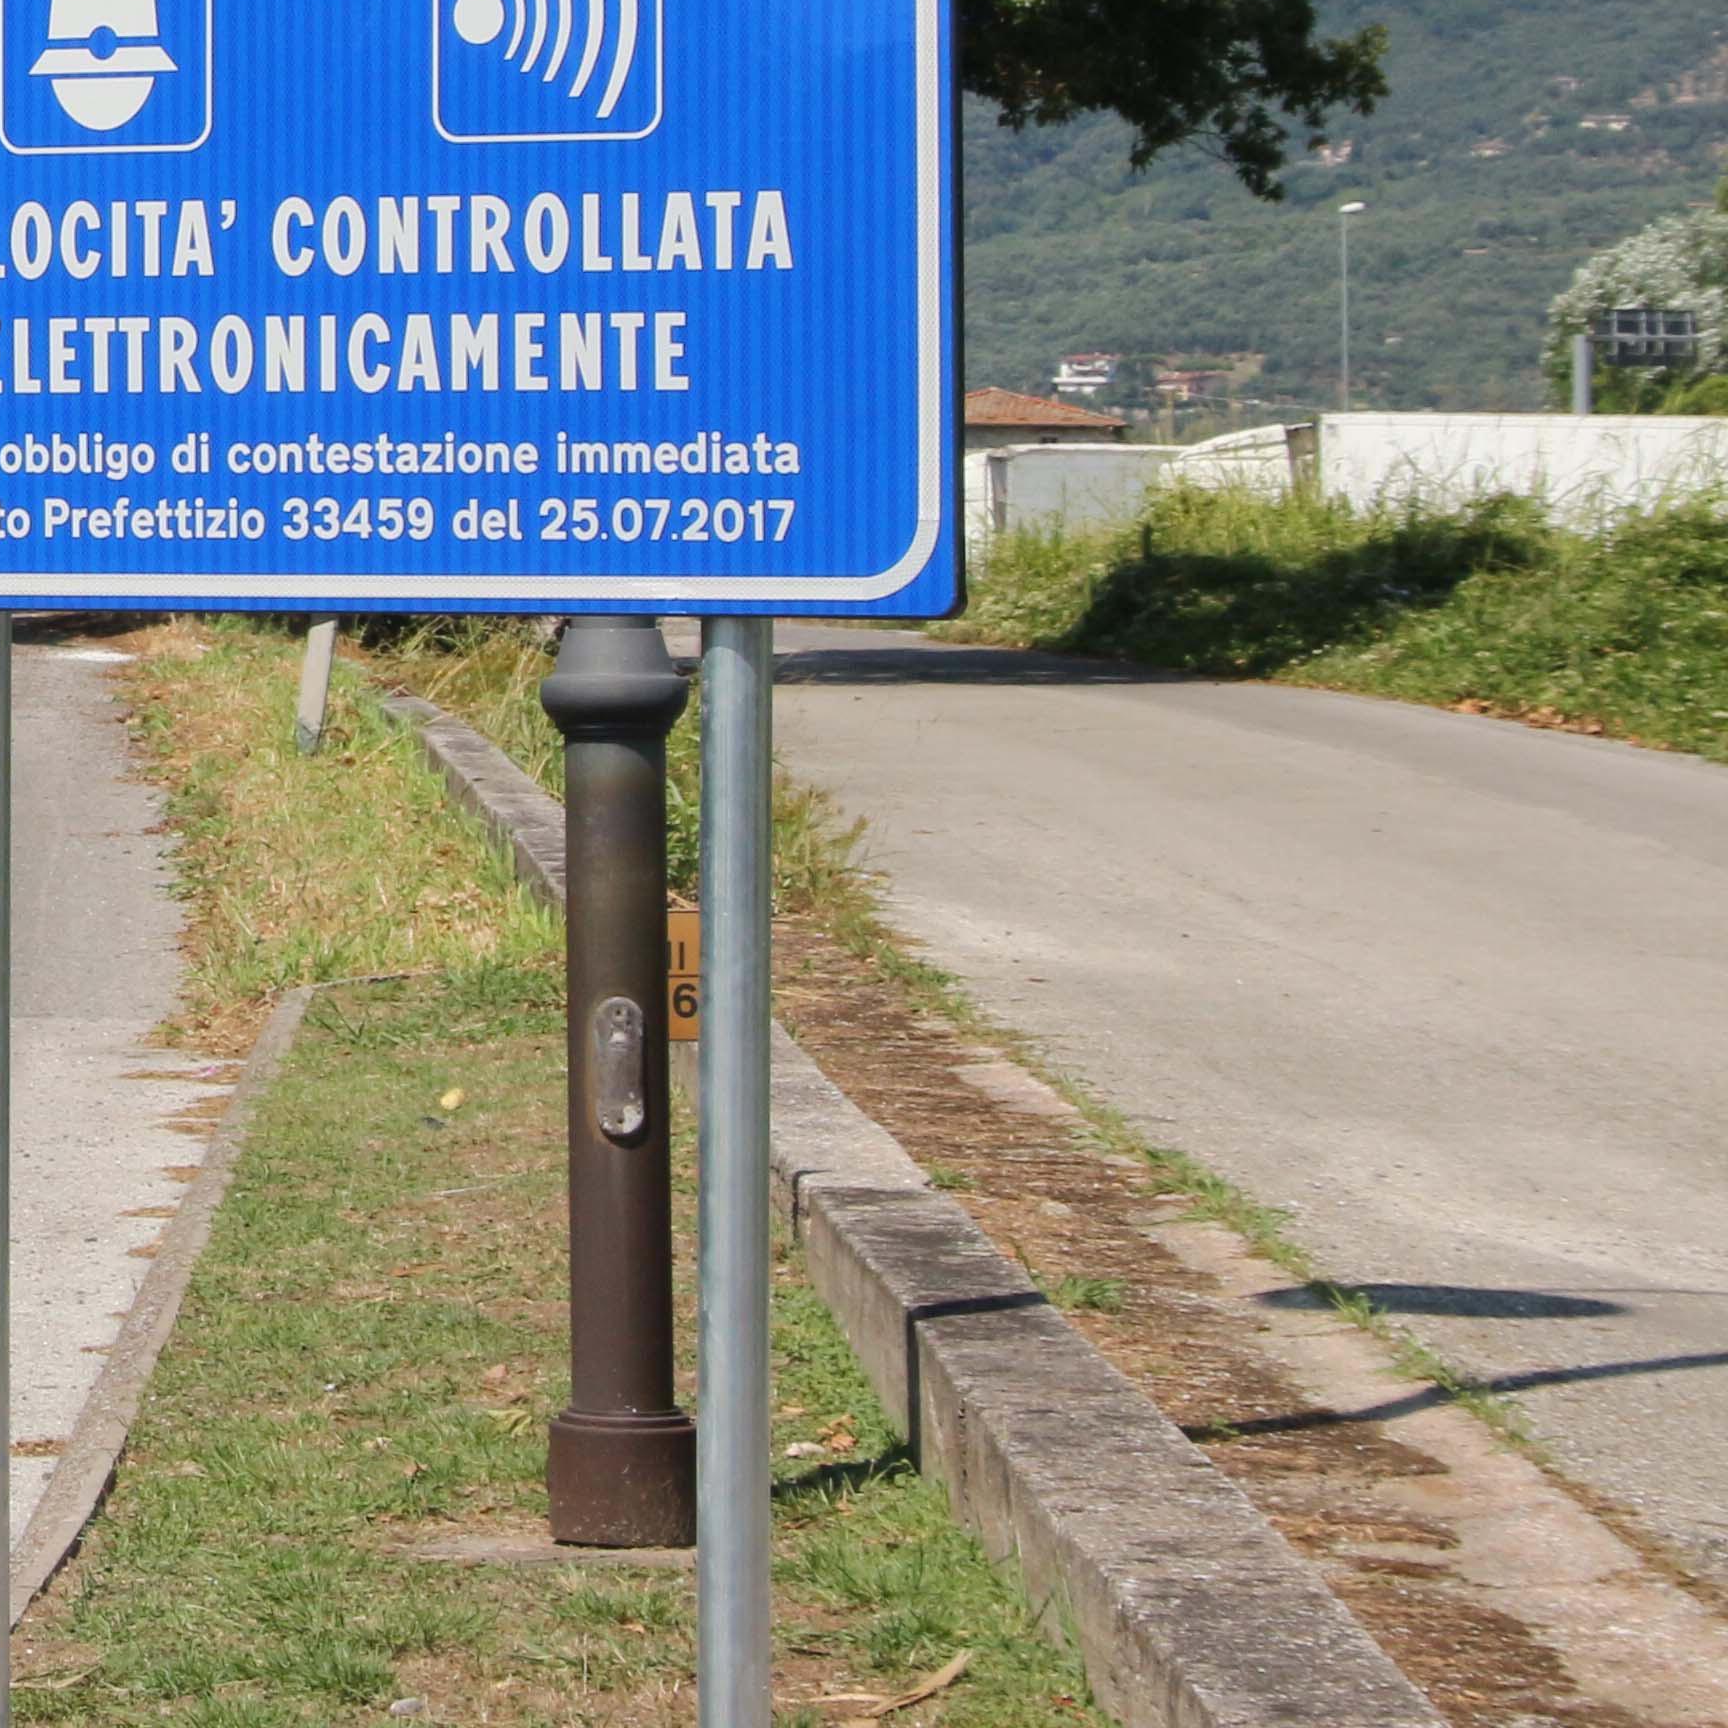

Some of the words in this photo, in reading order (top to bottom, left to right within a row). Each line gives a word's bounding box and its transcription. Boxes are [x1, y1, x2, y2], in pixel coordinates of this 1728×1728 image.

[272, 190, 793, 277] CONTROLLATA
[0, 432, 156, 480] obbligo
[171, 432, 210, 473] di
[227, 431, 539, 474] contestazione
[557, 431, 801, 474] immediata
[44, 497, 266, 539] Prefettizio
[283, 497, 434, 540] 33459
[452, 499, 523, 540] del
[539, 498, 796, 542] 25.07.2017
